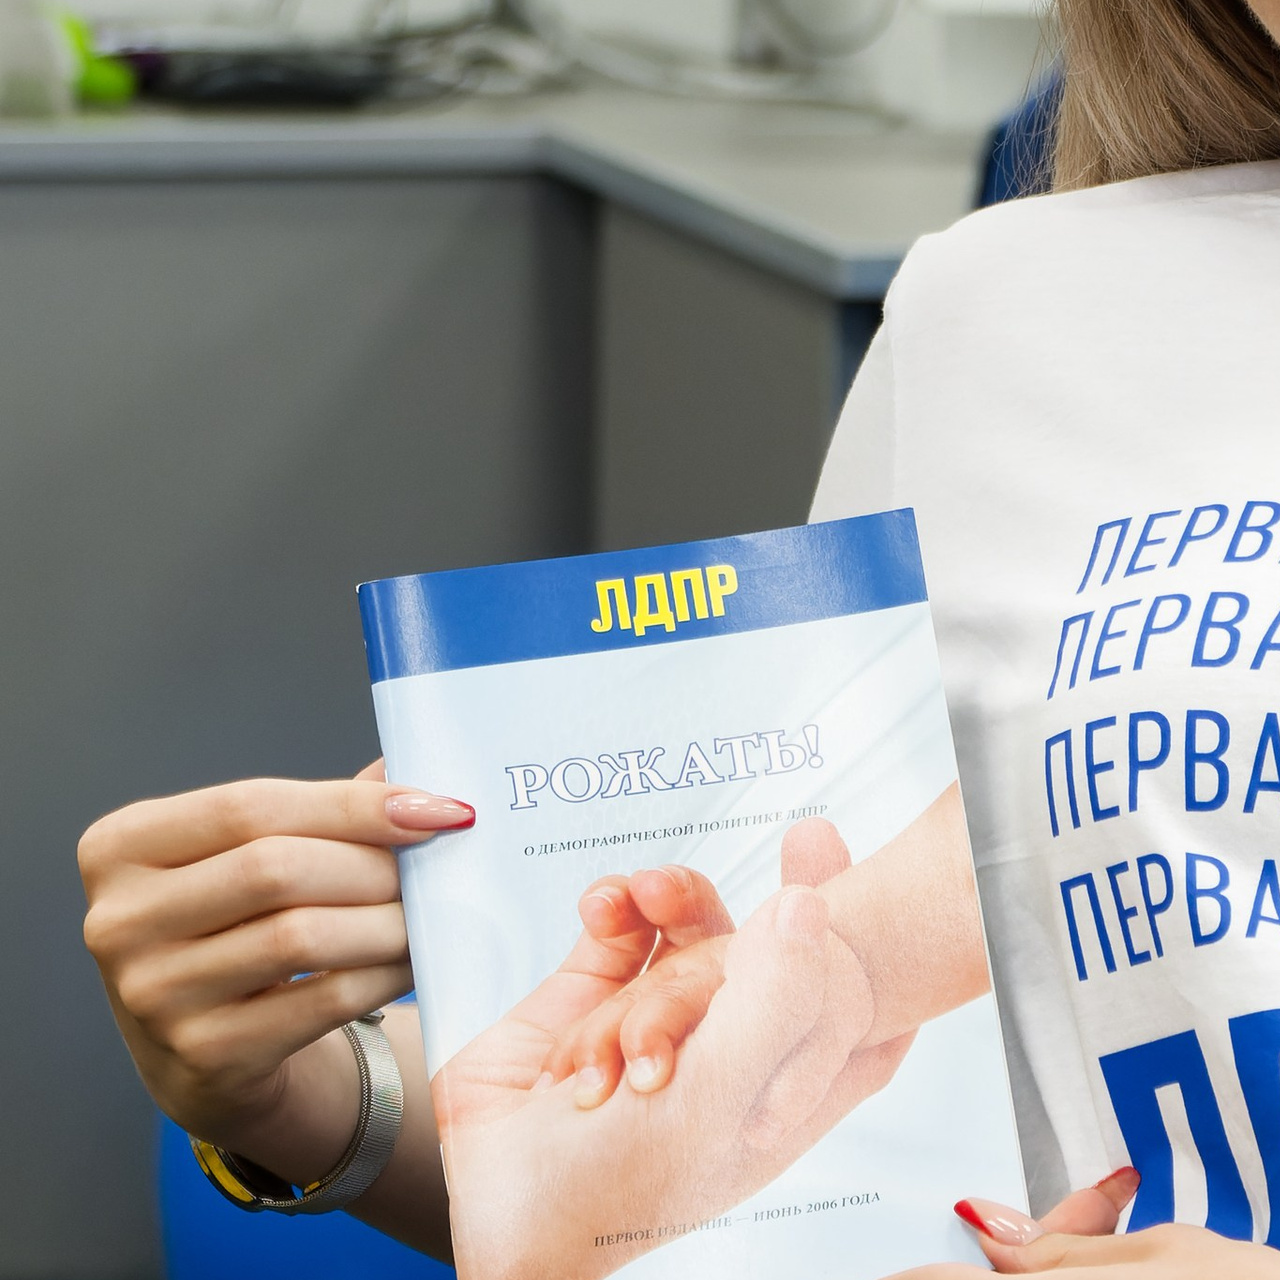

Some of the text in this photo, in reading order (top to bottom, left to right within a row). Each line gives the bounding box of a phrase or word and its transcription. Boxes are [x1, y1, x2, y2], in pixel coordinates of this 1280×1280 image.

[591, 564, 738, 636] ЛДПР
[505, 724, 825, 811] РОЖАТЬ!
[523, 804, 828, 858] О ДЕМОГРАФИЧЕСКОЙ ПОЛИТИКЕ ЛДПР
[594, 1191, 881, 1248] ПЕРВОЕ ИЗДАНИЕ ИЮНЬ 2006 ГОДА
